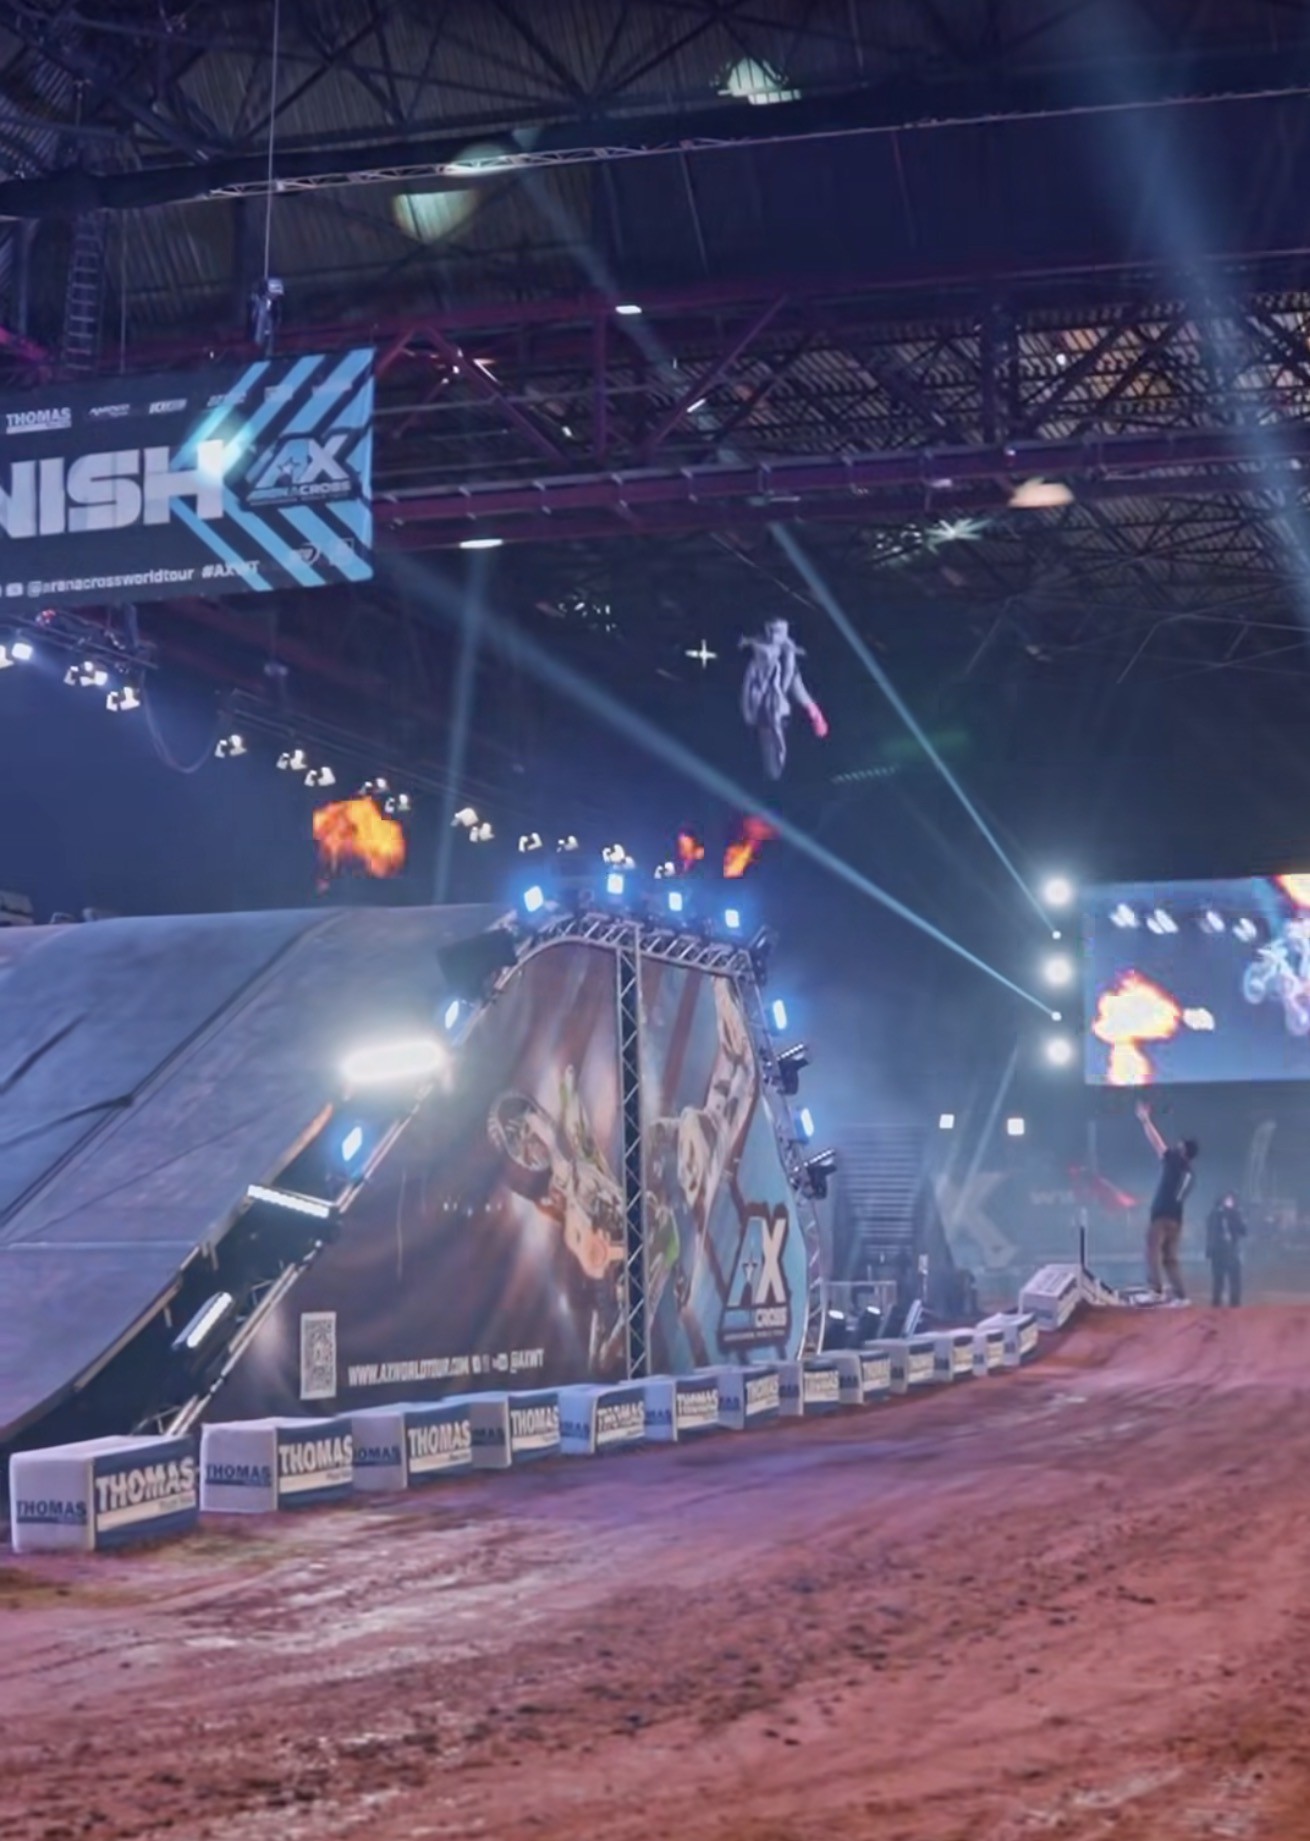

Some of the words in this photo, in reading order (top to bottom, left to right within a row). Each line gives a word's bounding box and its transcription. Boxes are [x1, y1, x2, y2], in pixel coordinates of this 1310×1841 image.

[6, 407, 71, 427] THOMAS
[511, 1406, 559, 1438] THOMAS
[279, 1435, 353, 1475] THOMAS
[408, 1420, 472, 1460] THOMAS
[96, 1456, 196, 1512] THOMAS
[206, 1463, 272, 1481] THOMAS
[17, 1500, 87, 1518] THOMAS
